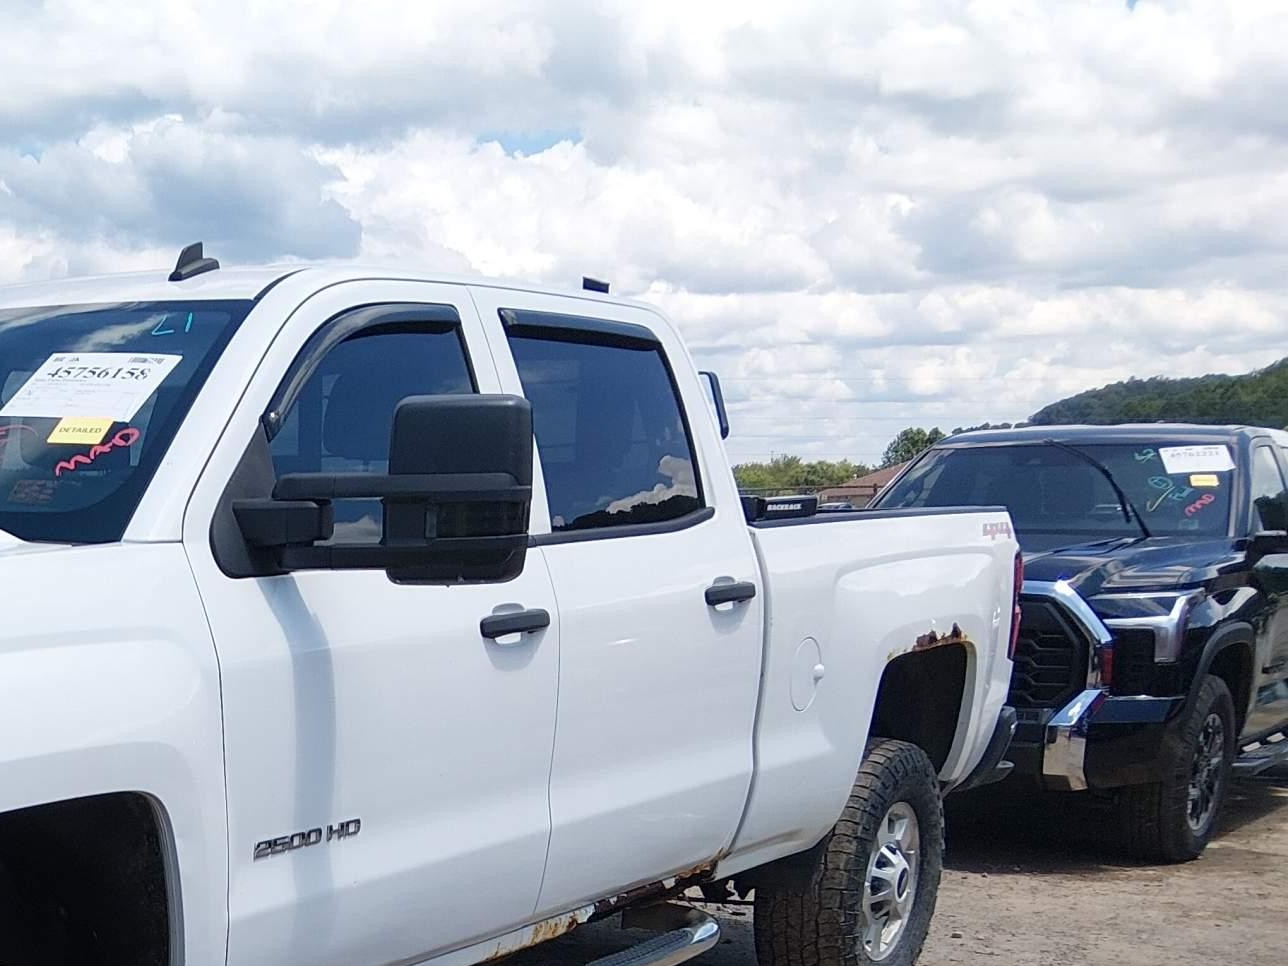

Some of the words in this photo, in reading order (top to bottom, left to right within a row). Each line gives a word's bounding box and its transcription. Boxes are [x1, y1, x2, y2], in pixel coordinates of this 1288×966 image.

[48, 366, 152, 381] 45756158
[253, 827, 323, 861] 2500
[326, 818, 361, 842] HD
